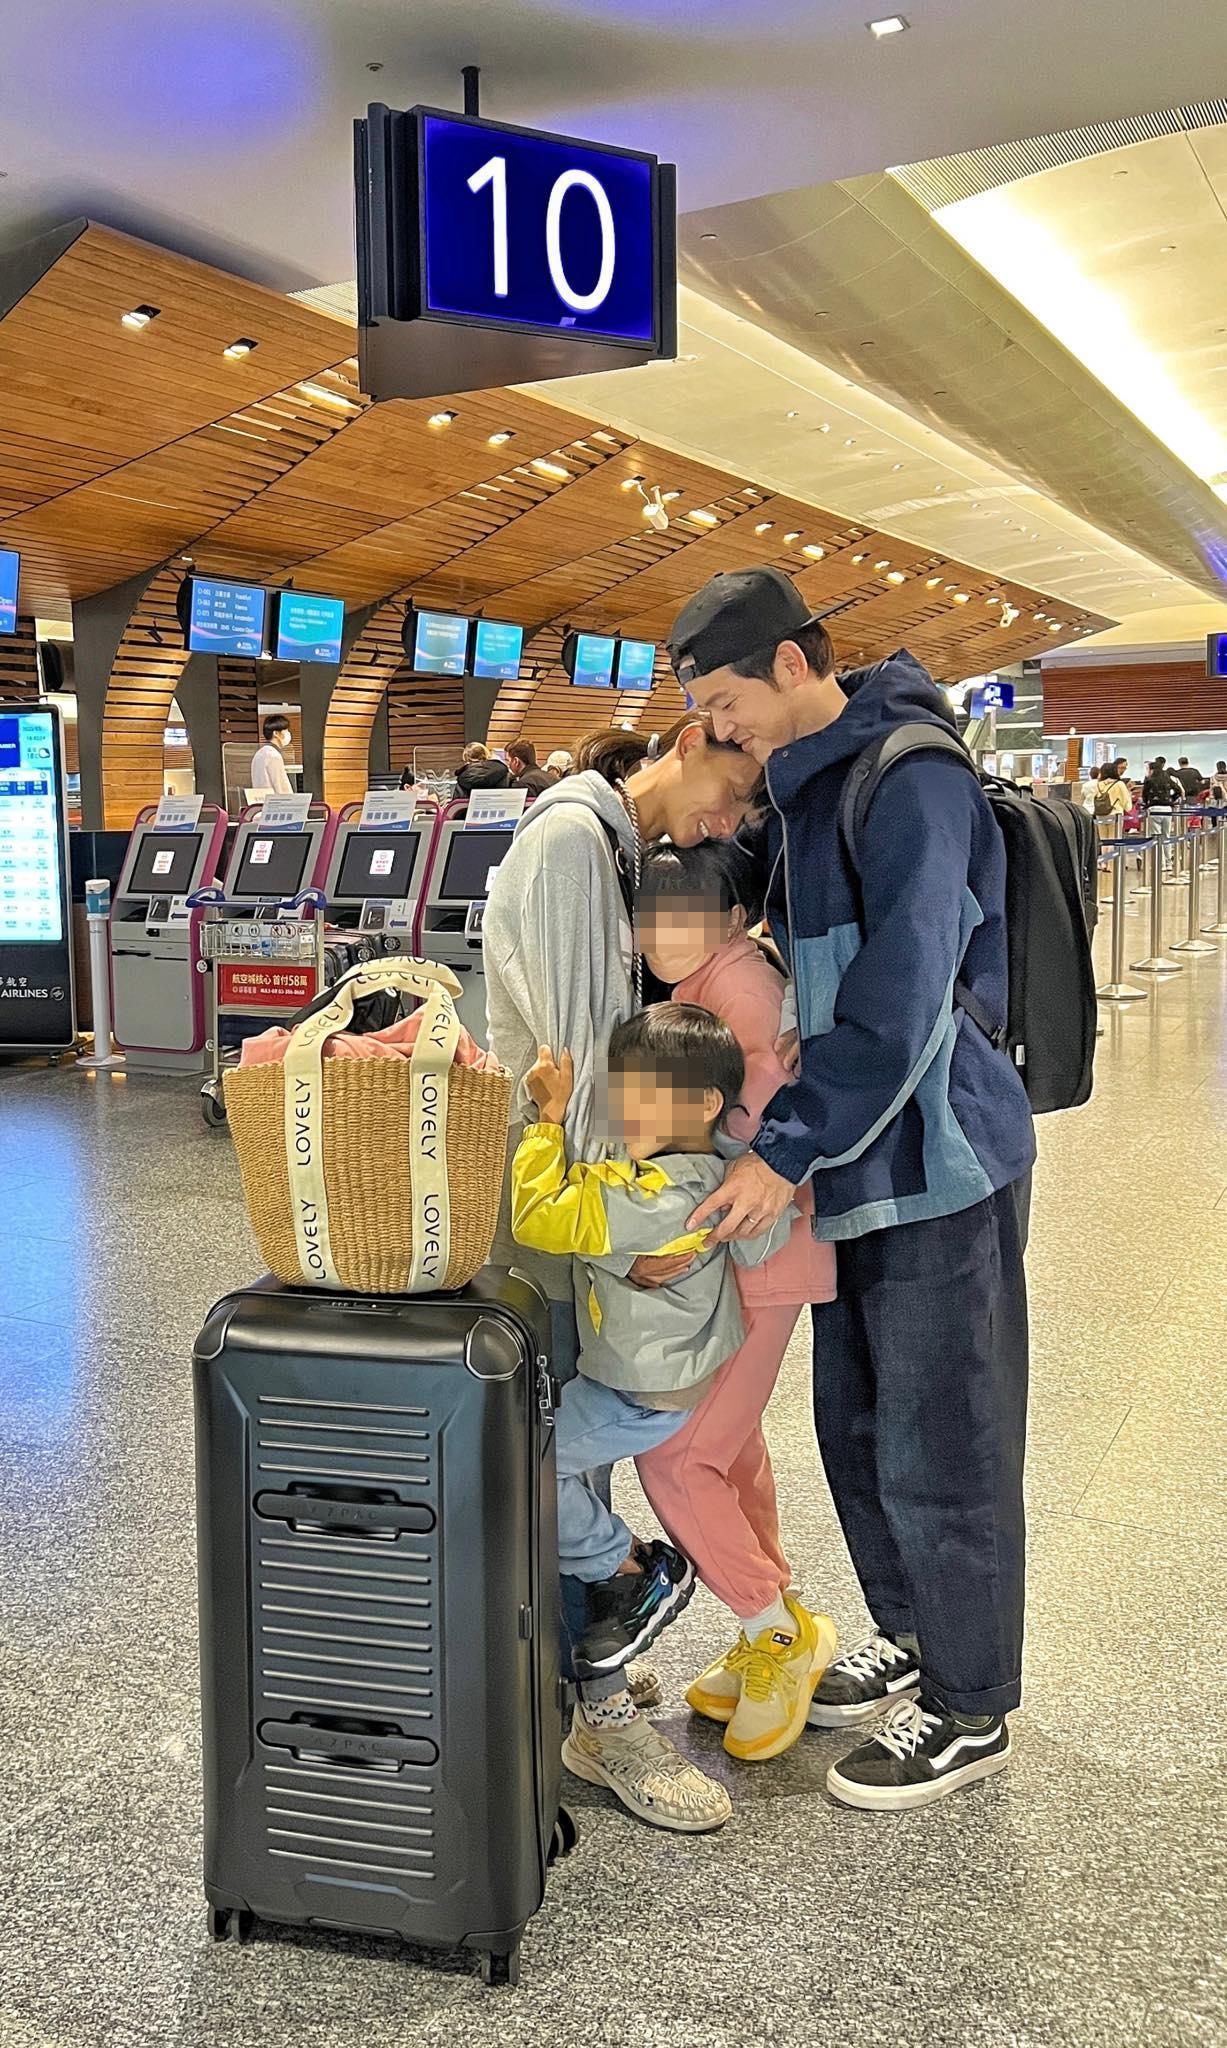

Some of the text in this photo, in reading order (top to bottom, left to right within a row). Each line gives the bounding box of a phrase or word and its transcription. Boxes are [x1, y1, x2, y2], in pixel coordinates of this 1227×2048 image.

[466, 155, 616, 311] 10
[1, 989, 49, 998] AIRLINES
[429, 990, 453, 1048] OVELY
[295, 1078, 311, 1166] LOVELY
[421, 1073, 438, 1160] LOVELY
[301, 1198, 327, 1280] LOVELY
[422, 1193, 440, 1279] LOVELY
